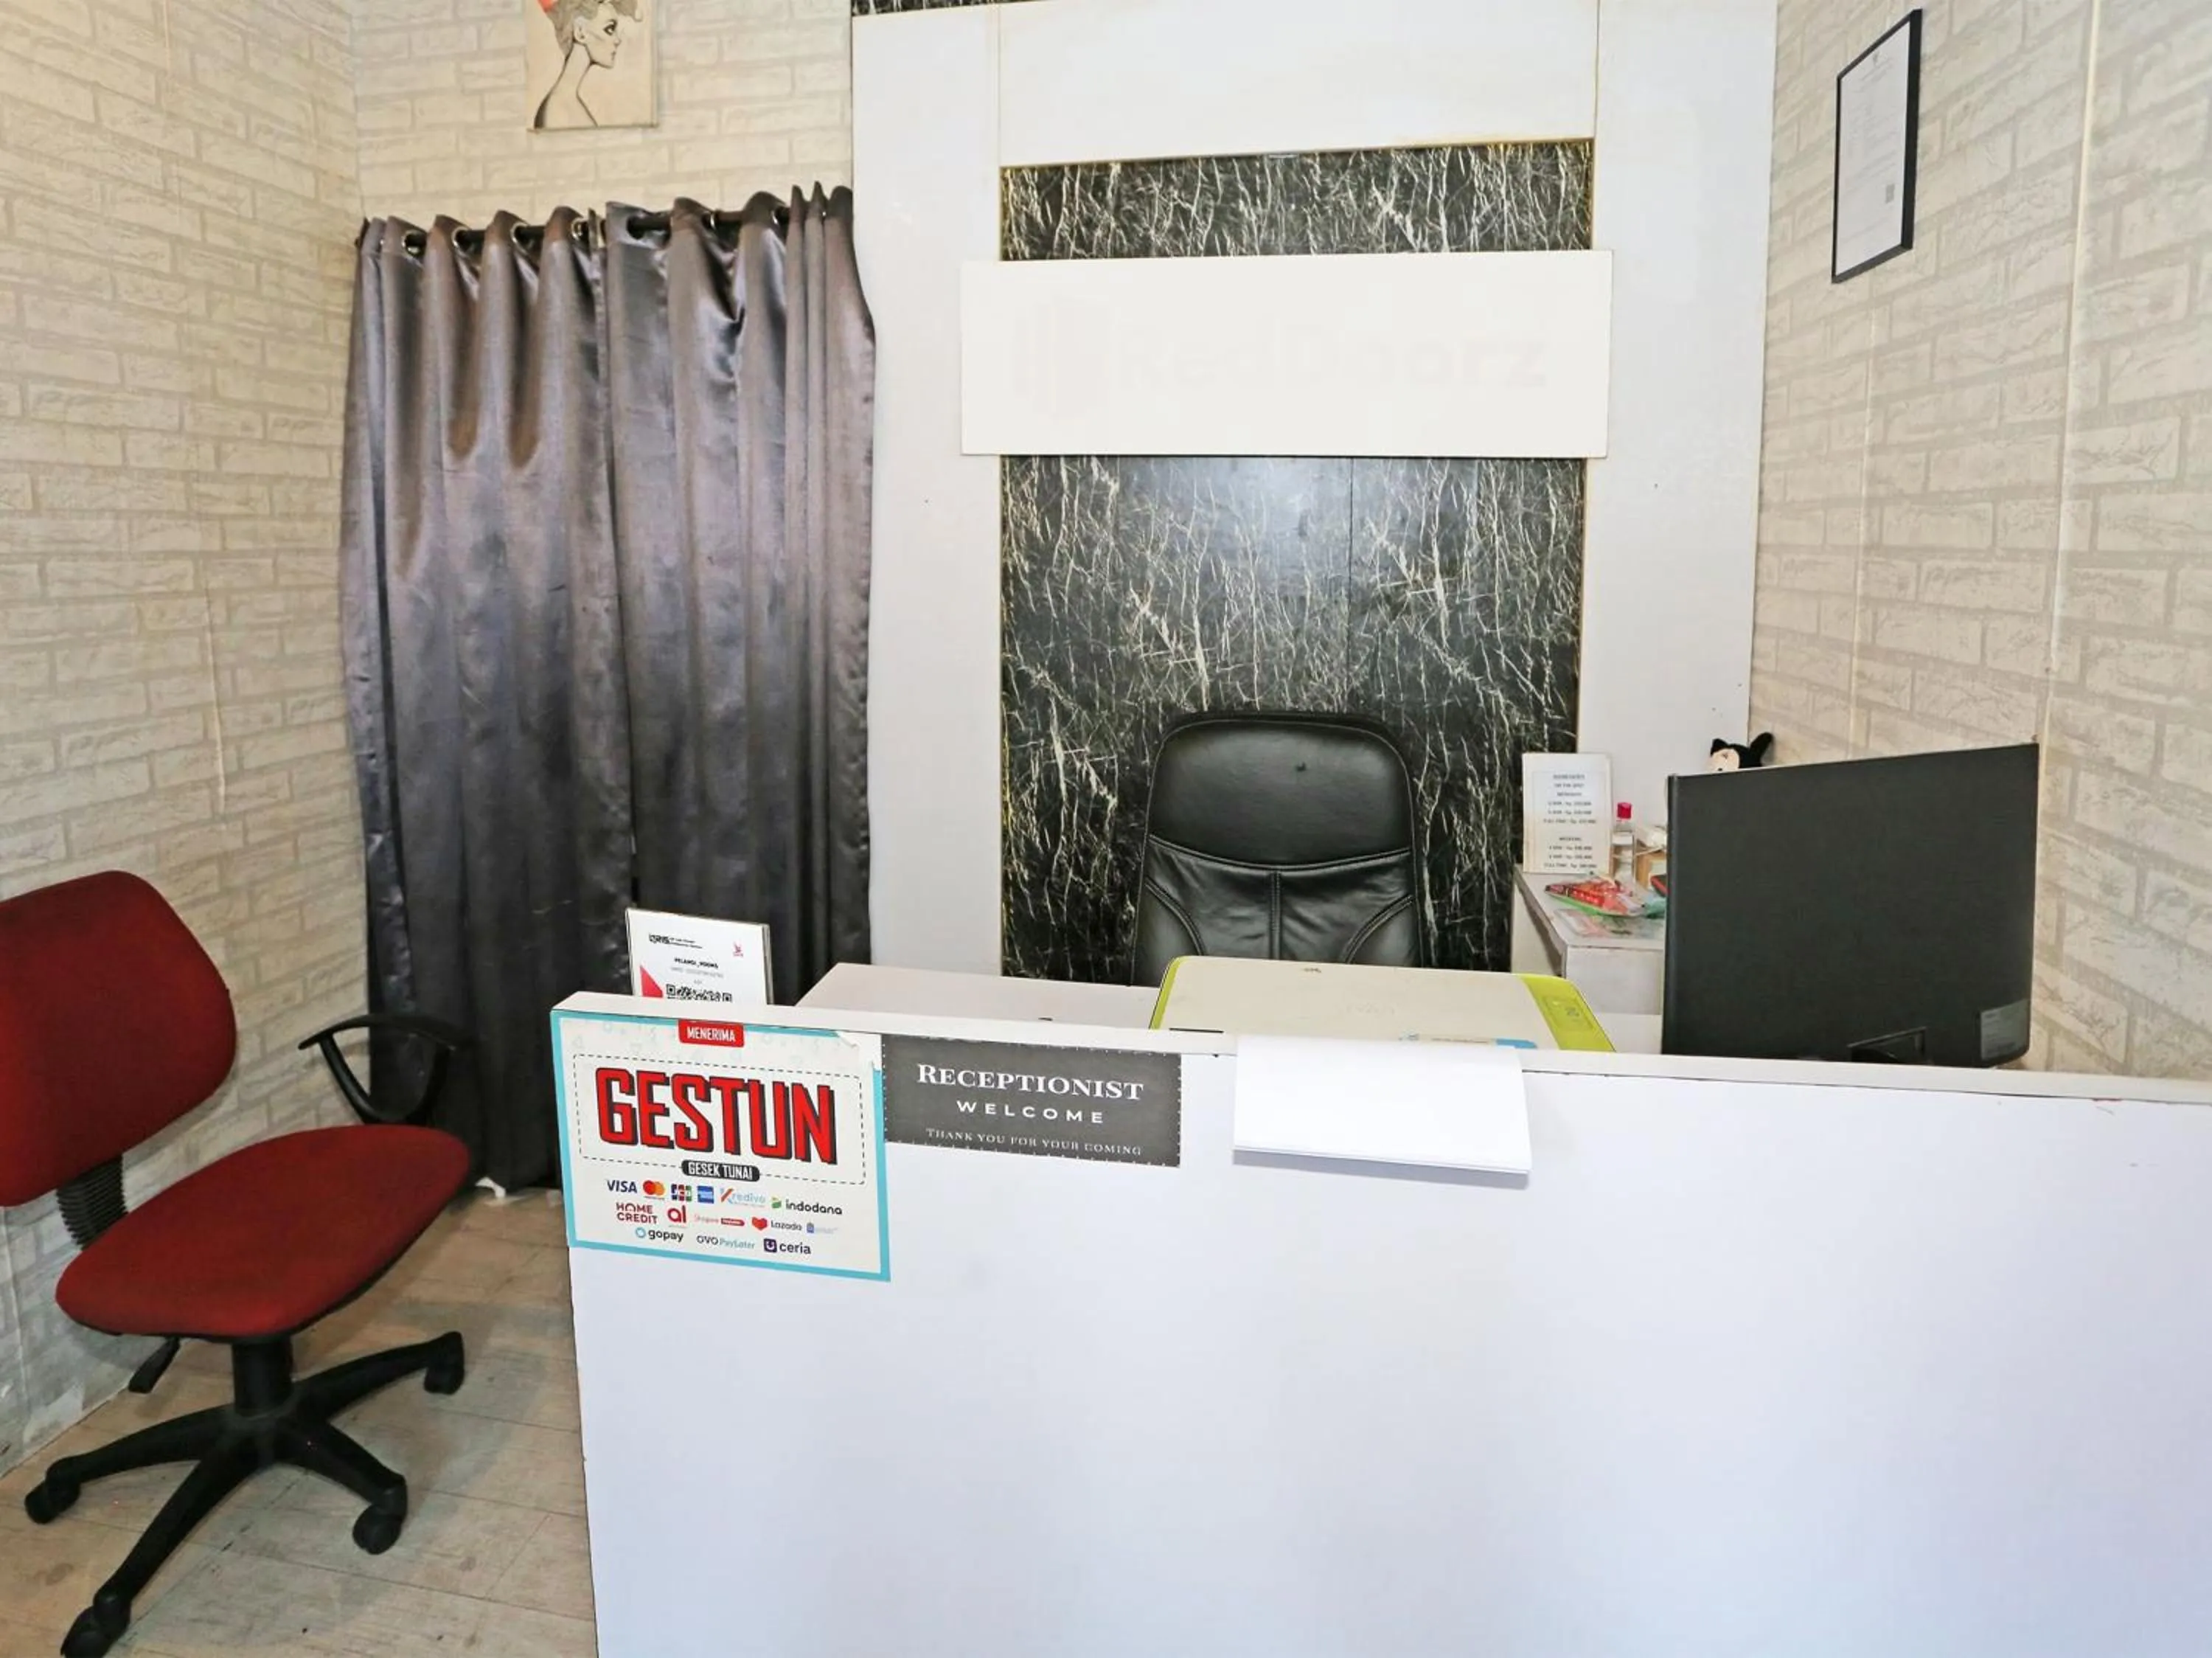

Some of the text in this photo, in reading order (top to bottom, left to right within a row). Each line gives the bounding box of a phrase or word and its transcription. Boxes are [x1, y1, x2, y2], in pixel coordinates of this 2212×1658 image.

[686, 1026, 737, 1043] MENERIMA
[596, 1067, 838, 1165] GESTUN
[956, 1100, 1104, 1124] WELCOME
[688, 1162, 753, 1180] GESEK TUNAI
[607, 1180, 637, 1193] VISA
[616, 1202, 653, 1214] HOME
[785, 1199, 843, 1215] indodana
[616, 1212, 658, 1224] CREDIT
[771, 1220, 802, 1231] Lazada
[648, 1229, 684, 1242] gopay
[779, 1242, 811, 1255] ceria
